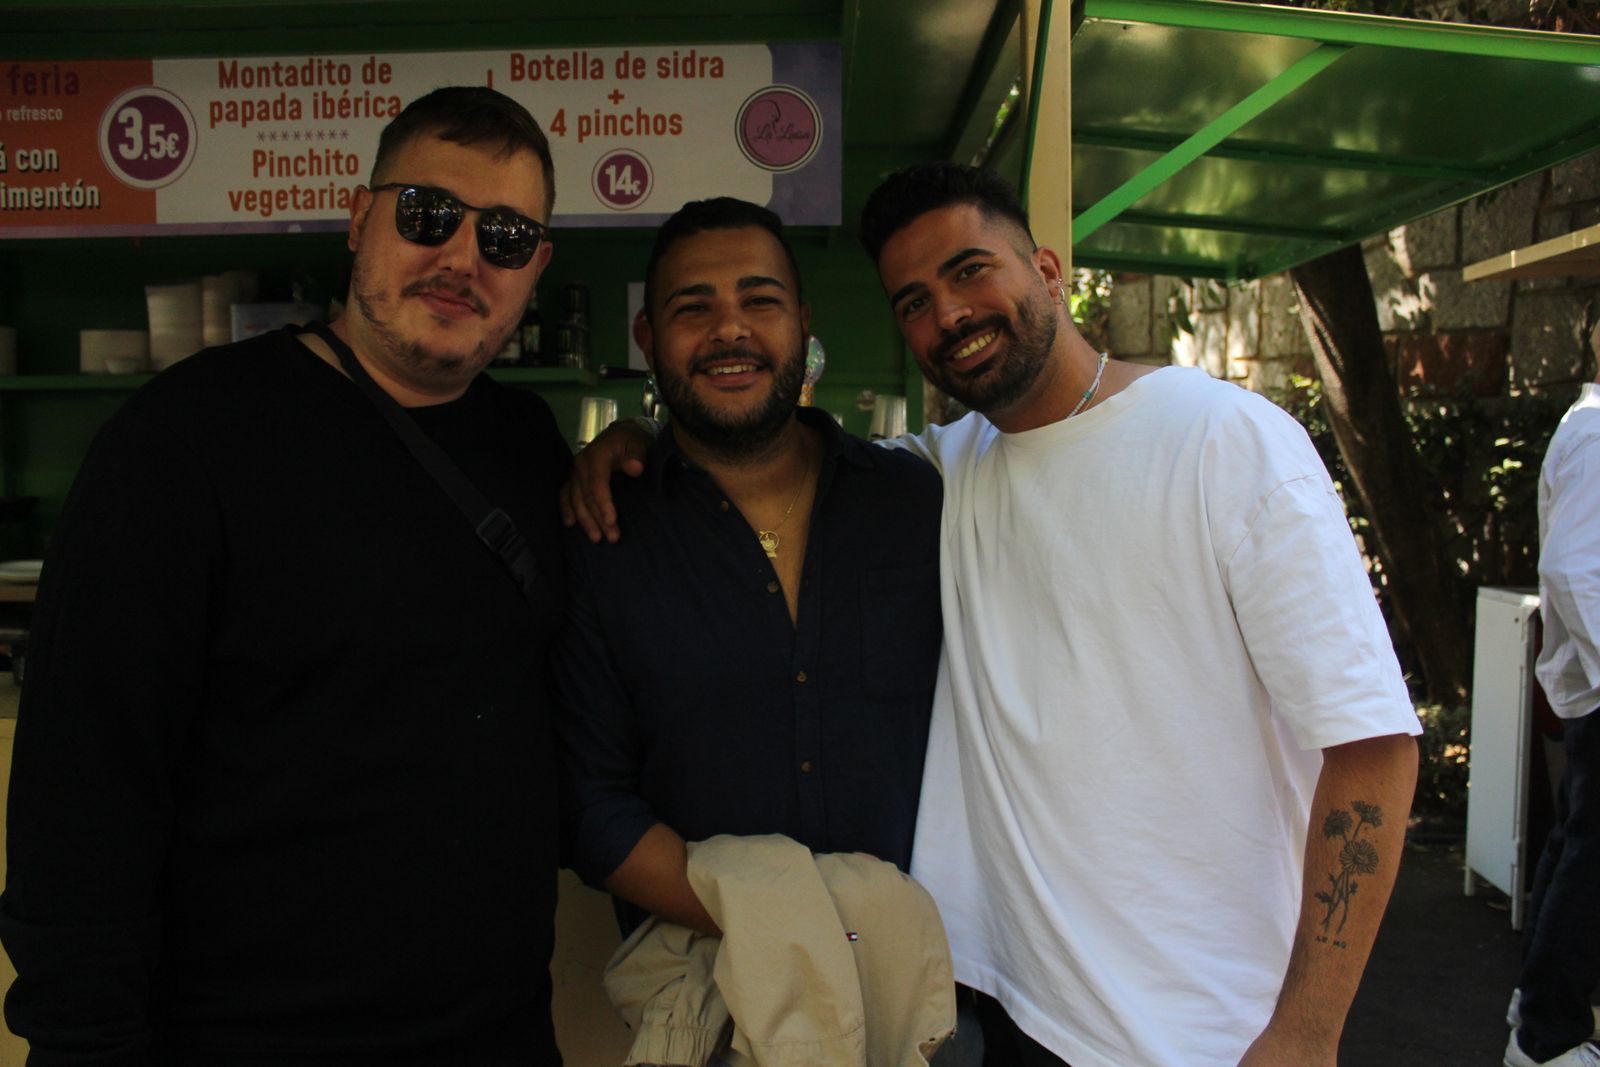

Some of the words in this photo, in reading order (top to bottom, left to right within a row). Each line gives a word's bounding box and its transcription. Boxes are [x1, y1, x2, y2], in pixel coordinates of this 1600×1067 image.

[7, 65, 80, 95] feria
[218, 58, 351, 89] Montadito
[362, 56, 392, 85] de
[510, 52, 604, 81] Botella
[615, 51, 646, 79] de
[657, 50, 724, 79] sidra
[7, 105, 63, 121] refresco
[210, 92, 302, 128] papada
[313, 89, 400, 119] ibérica
[550, 108, 567, 136] 4
[578, 107, 682, 142] pinchos
[15, 147, 59, 172] con
[252, 148, 359, 177] Pinchito
[228, 182, 350, 217] vegetaria
